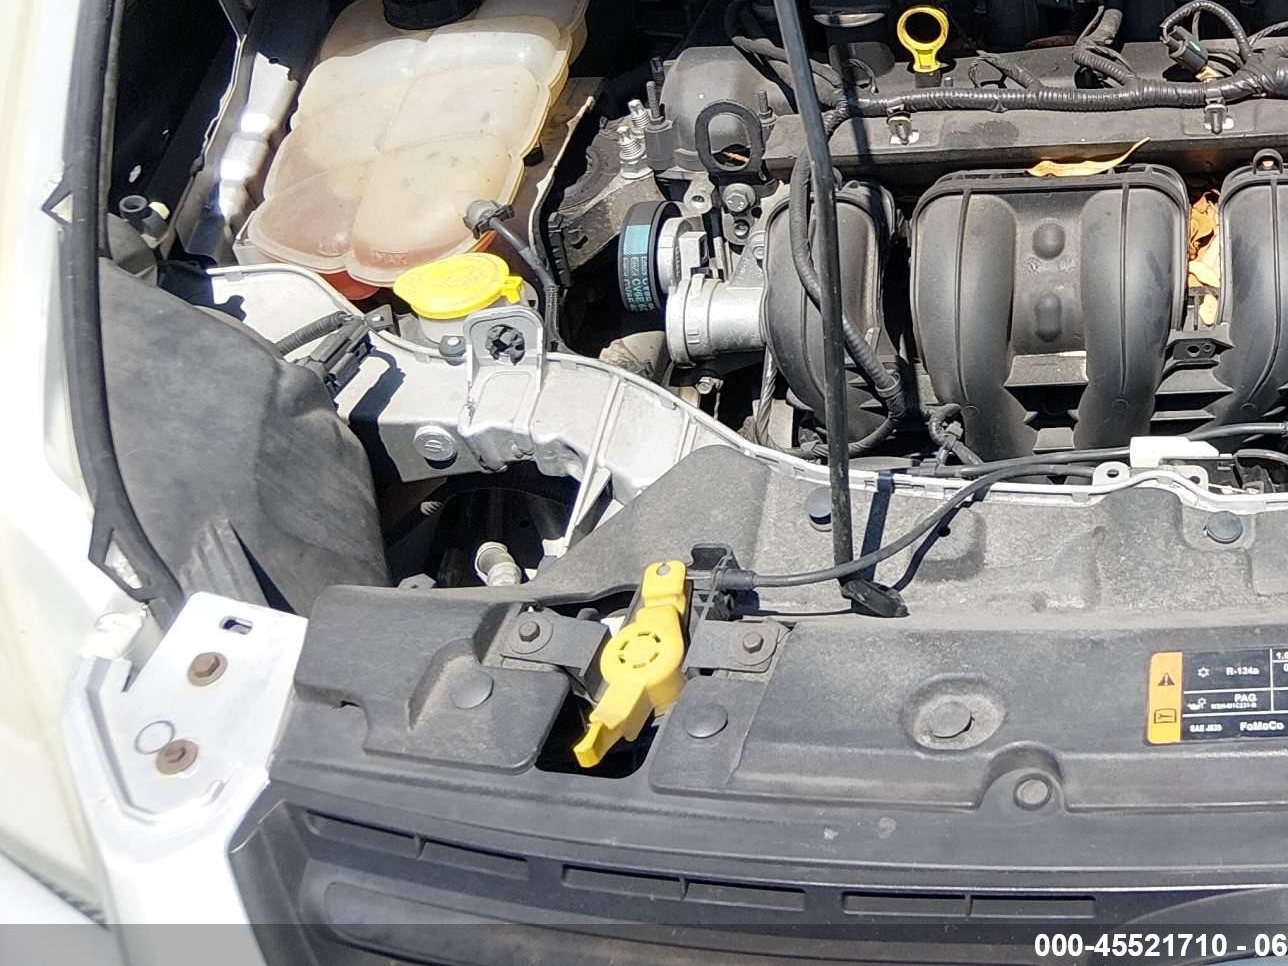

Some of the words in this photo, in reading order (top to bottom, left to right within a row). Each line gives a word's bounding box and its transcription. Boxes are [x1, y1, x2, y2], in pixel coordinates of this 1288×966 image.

[1225, 666, 1260, 676] R-134a
[1234, 693, 1257, 703] PAG
[1239, 720, 1285, 732] FoMoCo
